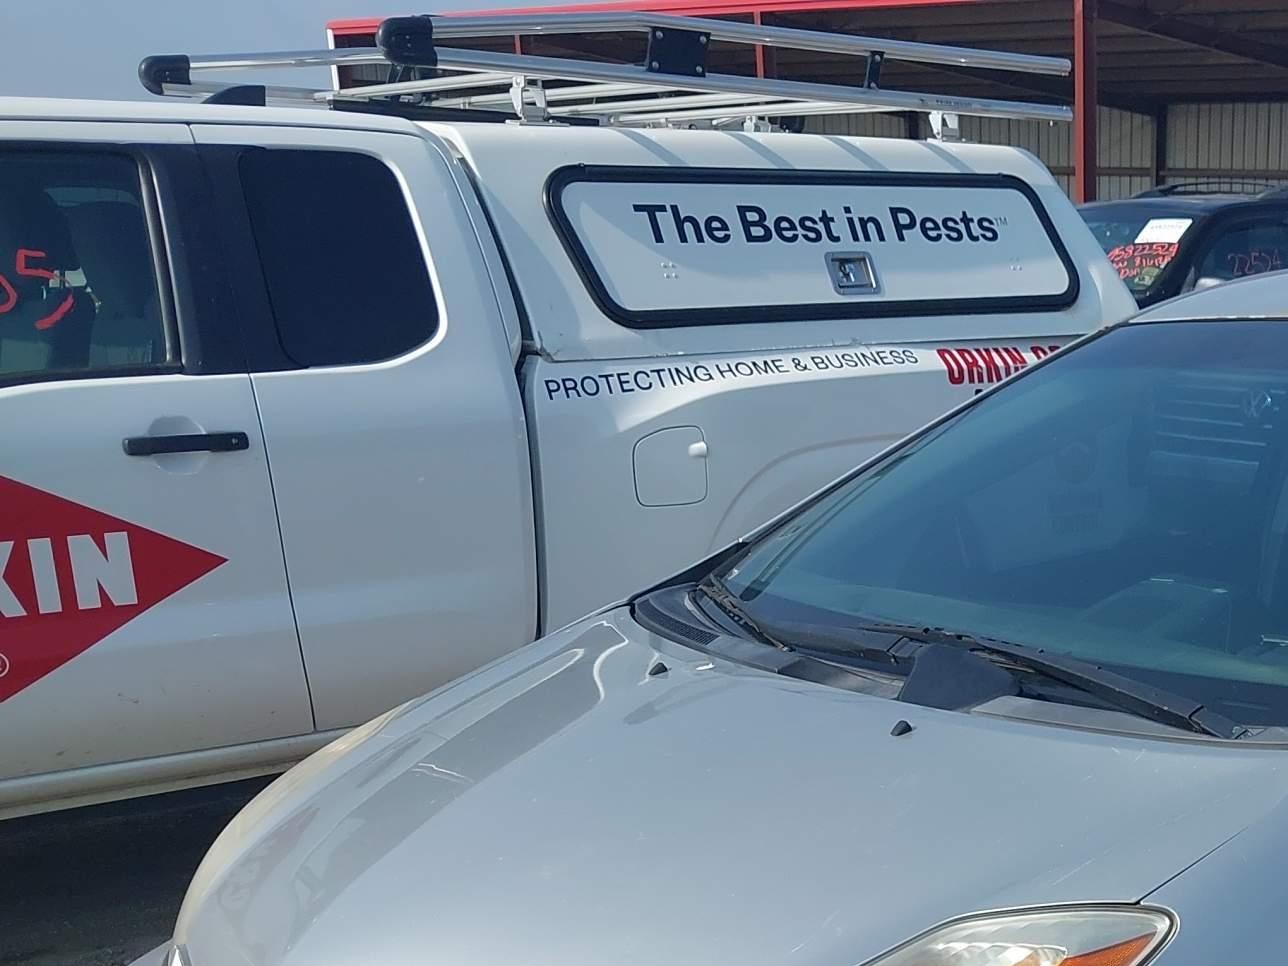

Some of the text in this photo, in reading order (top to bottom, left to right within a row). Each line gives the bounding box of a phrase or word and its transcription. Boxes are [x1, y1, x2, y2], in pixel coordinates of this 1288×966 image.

[632, 203, 732, 244] The
[735, 204, 842, 244] Best
[843, 206, 887, 243] in
[544, 349, 920, 401] PROTECTING HOME & BUSINESS
